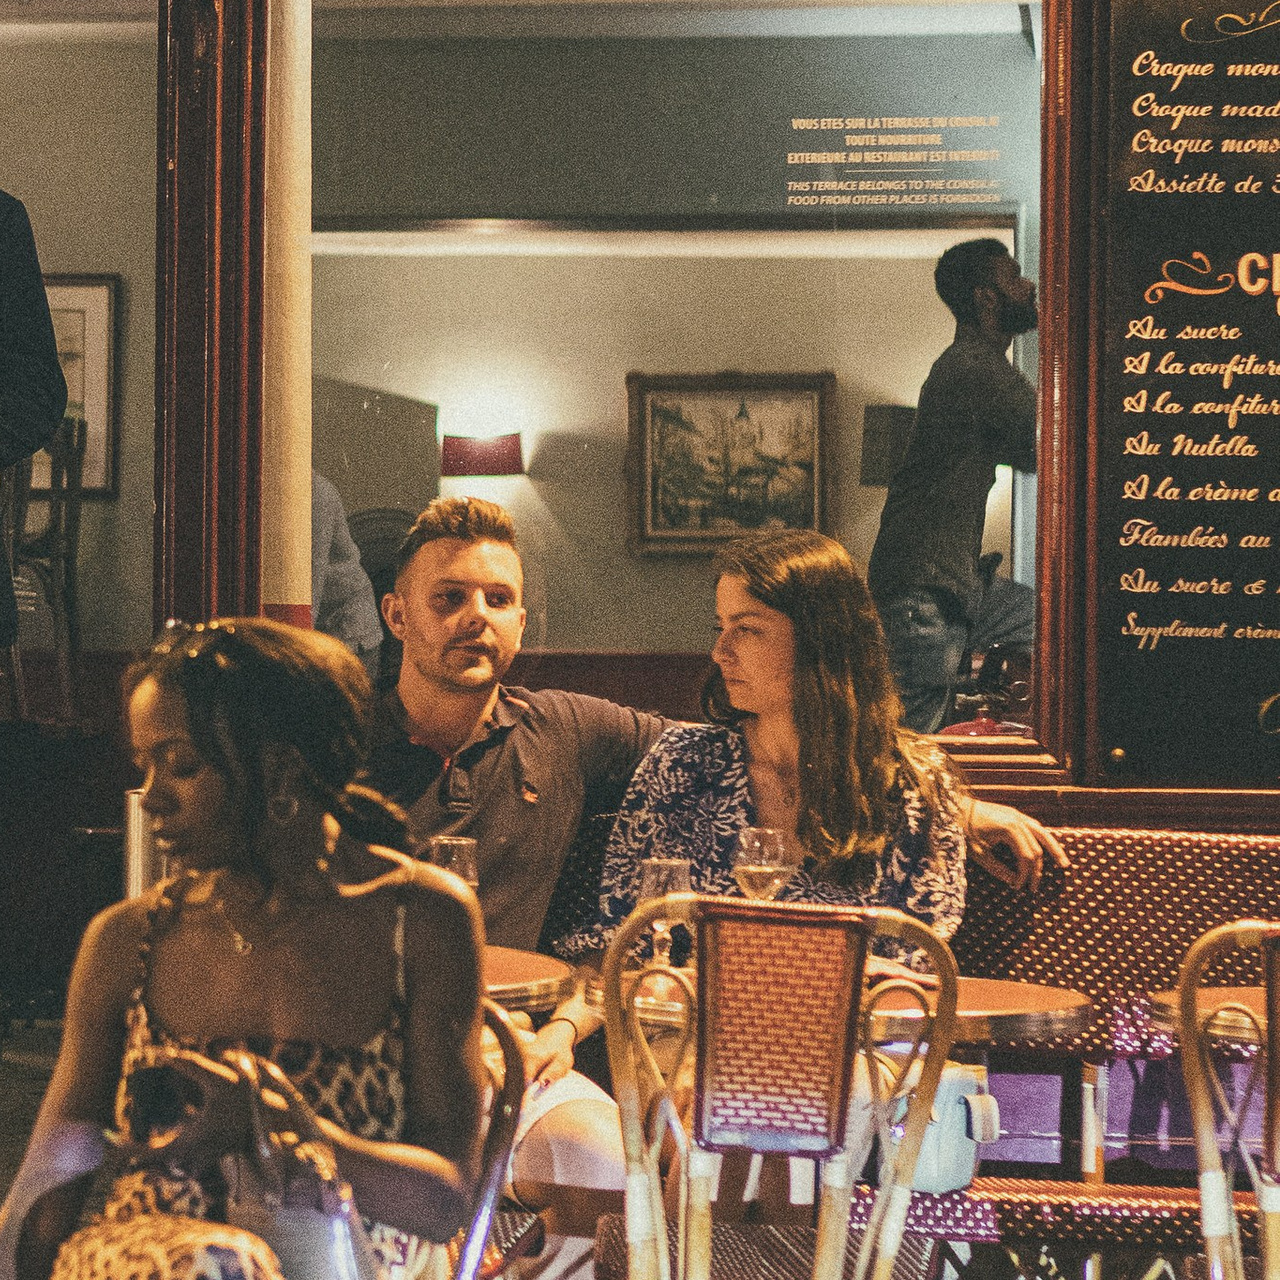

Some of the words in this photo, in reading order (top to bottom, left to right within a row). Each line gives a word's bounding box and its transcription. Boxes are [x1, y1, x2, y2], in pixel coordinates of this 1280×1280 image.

[1132, 50, 1214, 92] Croque
[791, 117, 819, 130] VOUS
[820, 117, 844, 130] ETES
[1132, 92, 1213, 131] Croque
[844, 134, 878, 147] TOUTE
[1131, 128, 1214, 164] Croque
[787, 180, 811, 191] THIS
[812, 180, 858, 191] TERRACE
[858, 180, 907, 191] BELONGS
[907, 180, 924, 190] TO
[923, 180, 947, 190] THE
[1127, 168, 1227, 194] Assiette
[1234, 174, 1264, 194] de
[787, 195, 820, 206] FOOD
[819, 195, 852, 205] FROM
[851, 194, 889, 205] OTHER
[887, 194, 928, 205] PLACES
[1237, 251, 1280, 296] C
[1125, 315, 1168, 340] Au
[1176, 324, 1242, 340] sucre
[1123, 351, 1151, 375] A
[1155, 351, 1186, 375] la
[1123, 389, 1149, 413] A
[1152, 391, 1184, 414] la
[1123, 431, 1162, 456] Au
[1172, 434, 1259, 457] Nutella
[1122, 474, 1150, 500] A
[1153, 477, 1181, 501] la
[1186, 480, 1260, 502] crème
[1120, 519, 1229, 548] Flambées
[1239, 535, 1271, 548] au
[1120, 568, 1161, 593] Au
[1169, 577, 1233, 595] sucre
